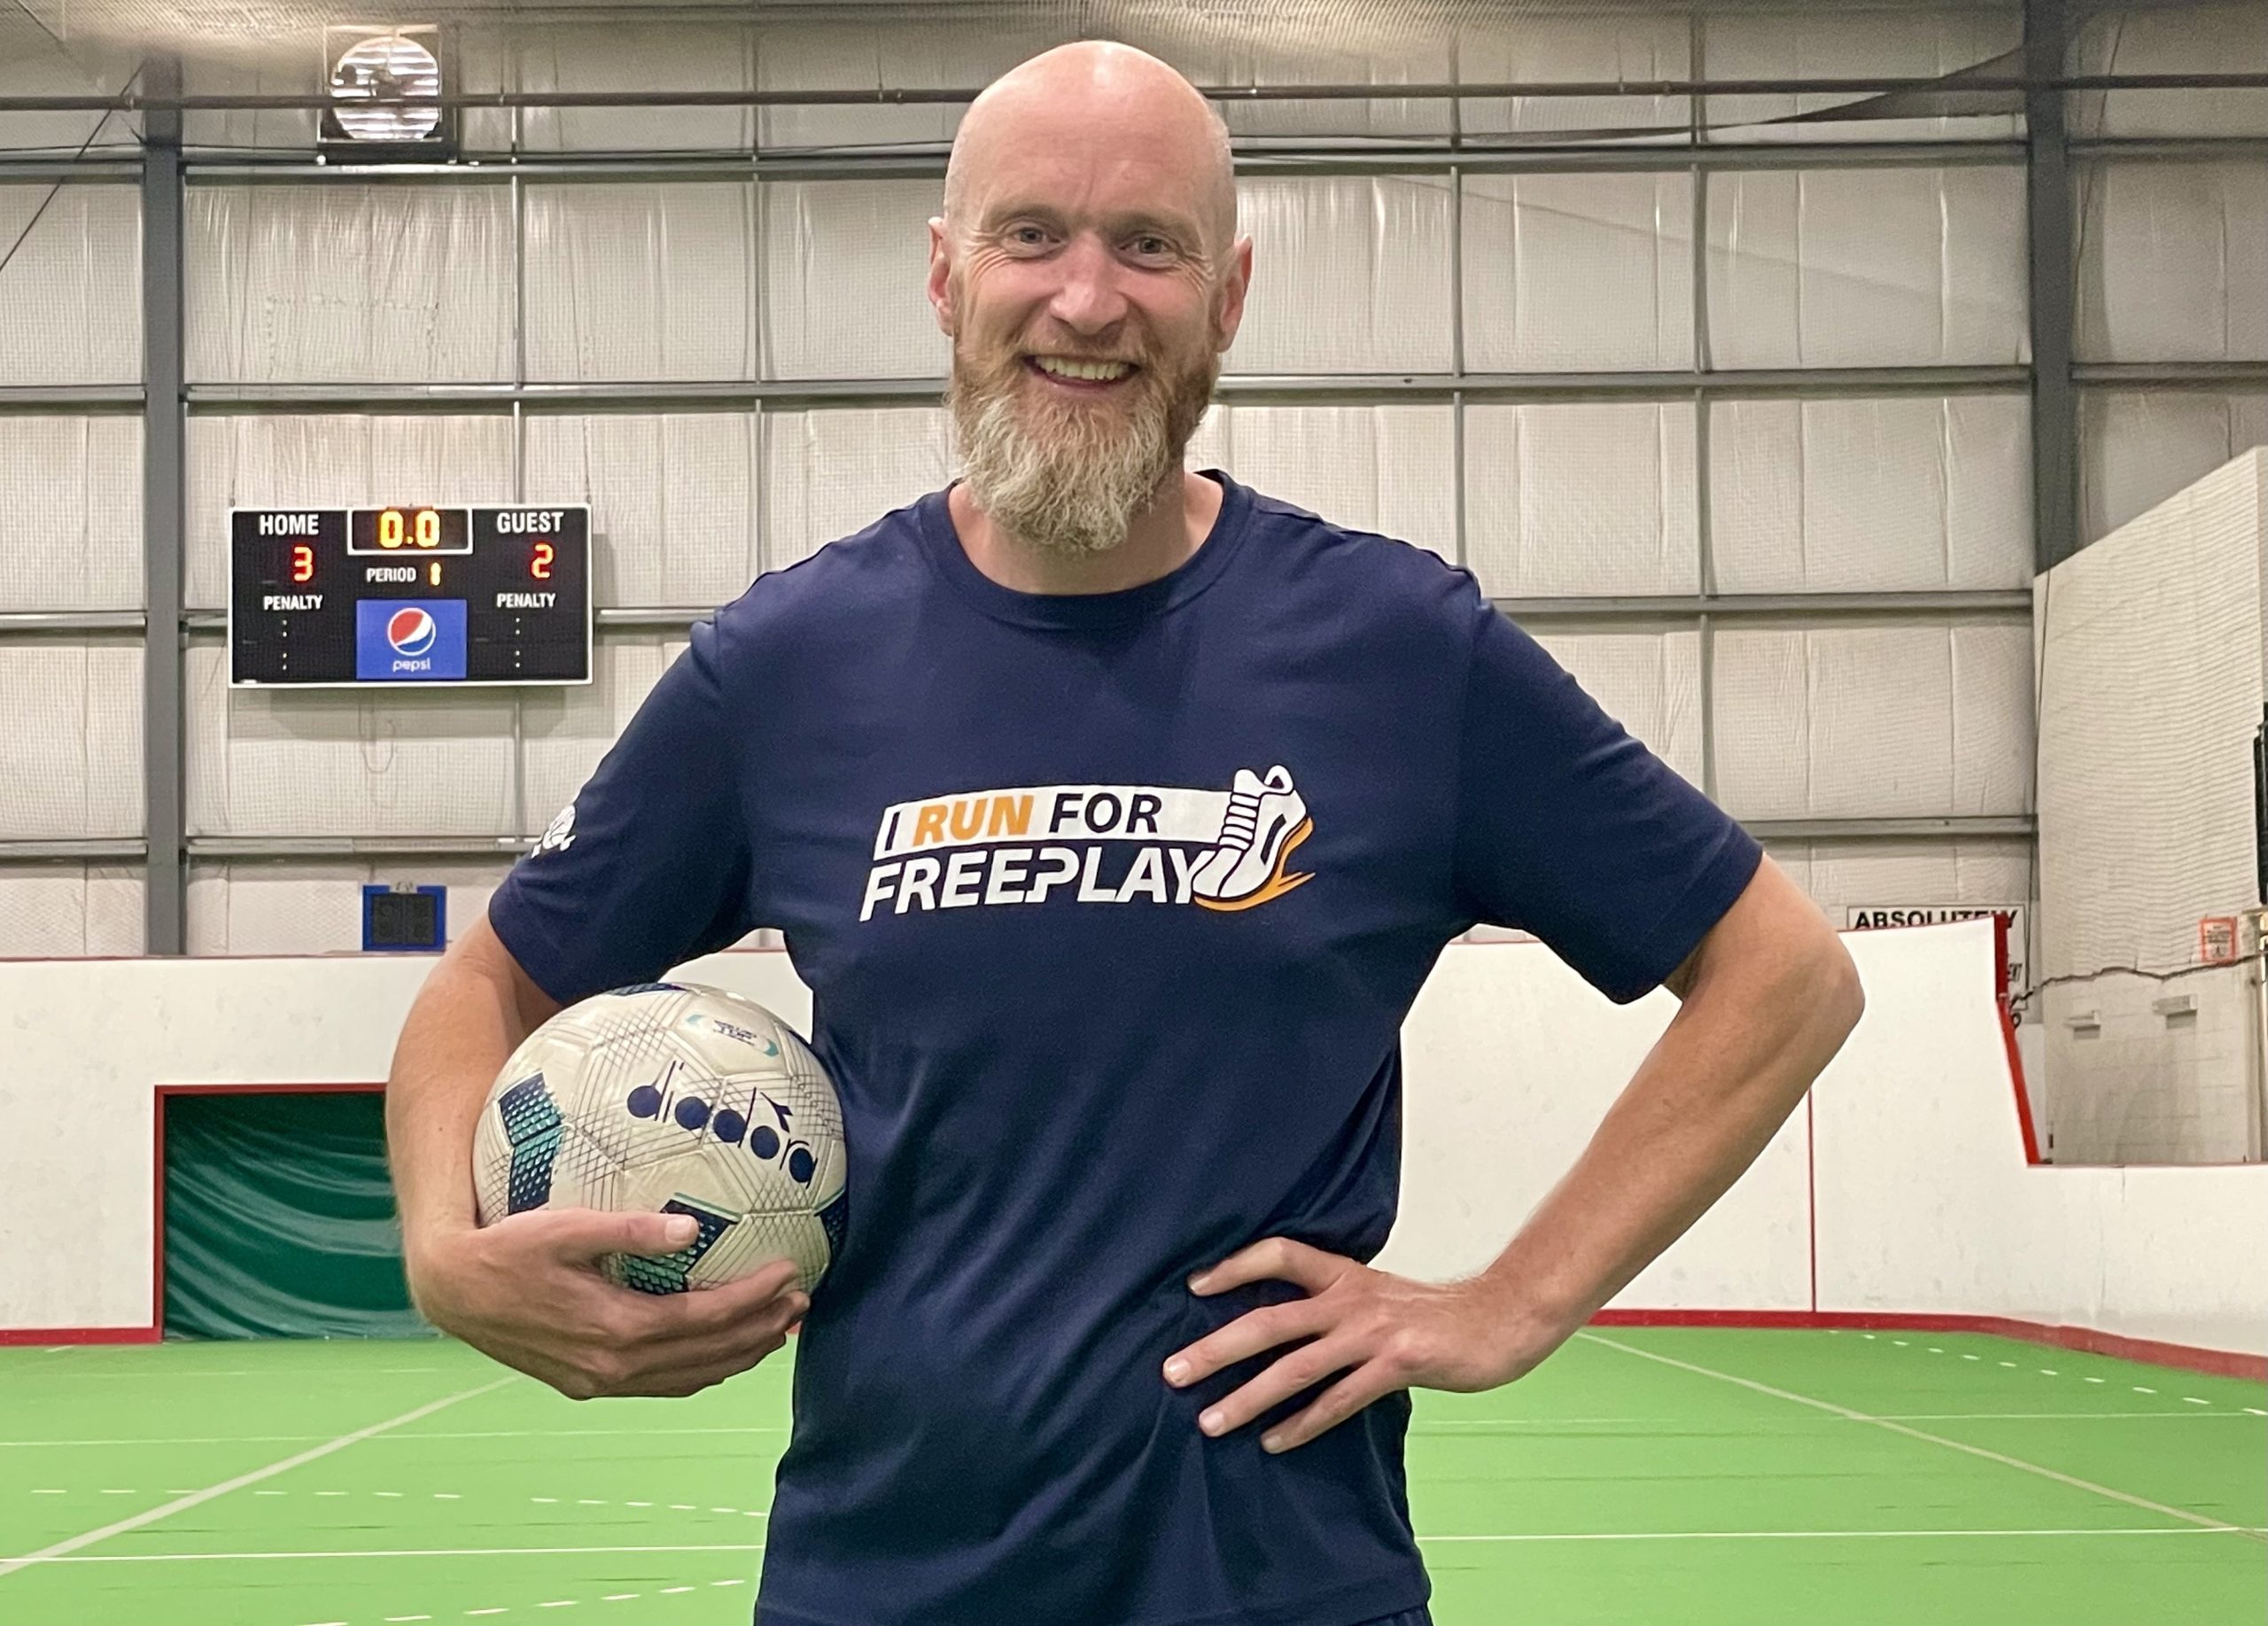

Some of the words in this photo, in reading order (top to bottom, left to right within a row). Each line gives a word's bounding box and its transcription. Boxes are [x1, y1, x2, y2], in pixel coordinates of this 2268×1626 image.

[259, 513, 320, 536] HOME
[379, 510, 440, 548] 0.0
[496, 511, 564, 533] GUEST
[293, 546, 314, 582] 3
[531, 542, 555, 579] 2
[366, 567, 417, 583] PERIOD
[263, 595, 323, 611] PENALTY
[496, 592, 556, 608] PENALTY
[392, 657, 431, 673] pepsi
[884, 811, 902, 852] I
[913, 795, 1035, 847] RUN
[1049, 792, 1162, 834] FOR
[858, 845, 1216, 922] FREEPLAY
